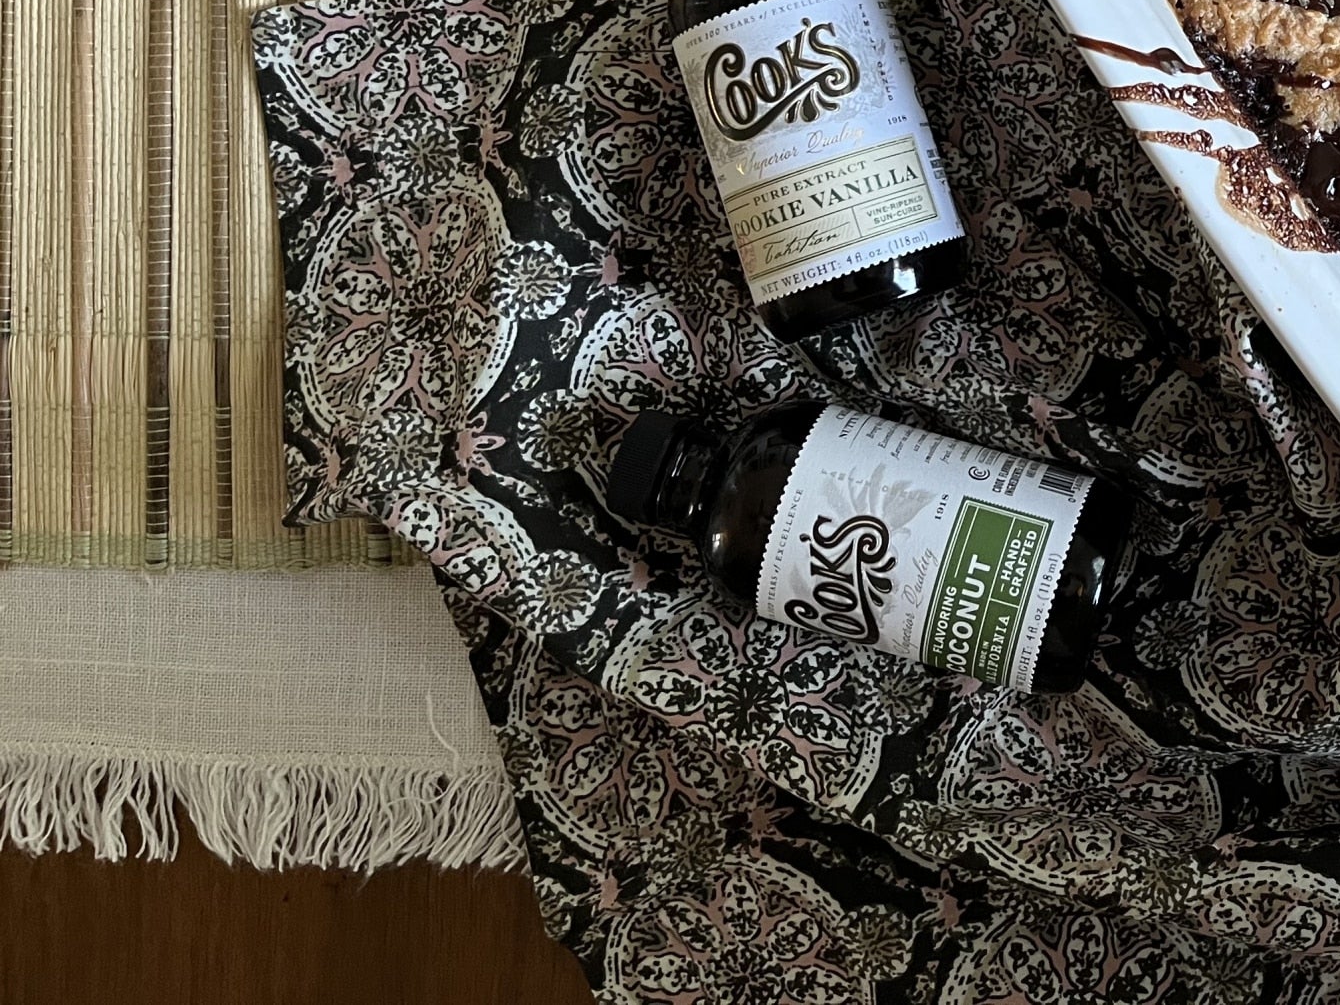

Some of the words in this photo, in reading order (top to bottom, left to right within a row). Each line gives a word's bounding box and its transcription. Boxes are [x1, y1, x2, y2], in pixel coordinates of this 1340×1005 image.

[723, 16, 756, 33] YEARS
[888, 115, 907, 126] 1918
[736, 148, 799, 179] Superior
[753, 186, 790, 207] PURE
[794, 161, 866, 192] EXTRACT
[734, 200, 805, 240] COOKIE
[808, 166, 918, 209] VANILLA
[866, 195, 923, 218] VINE-RIPENED
[873, 205, 923, 225] SUN-CURED
[761, 281, 779, 296] NET
[781, 261, 841, 288] WEIGHT:
[935, 494, 949, 520] 1918
[770, 576, 778, 600] YEARS
[776, 488, 804, 561] EXCELLENCE
[902, 548, 938, 608] Quality
[1009, 530, 1037, 597] CRAFTED
[933, 587, 957, 653] FLAVORING
[946, 554, 991, 673] COCONUT
[979, 651, 987, 667] MADE
[982, 641, 989, 649] IN
